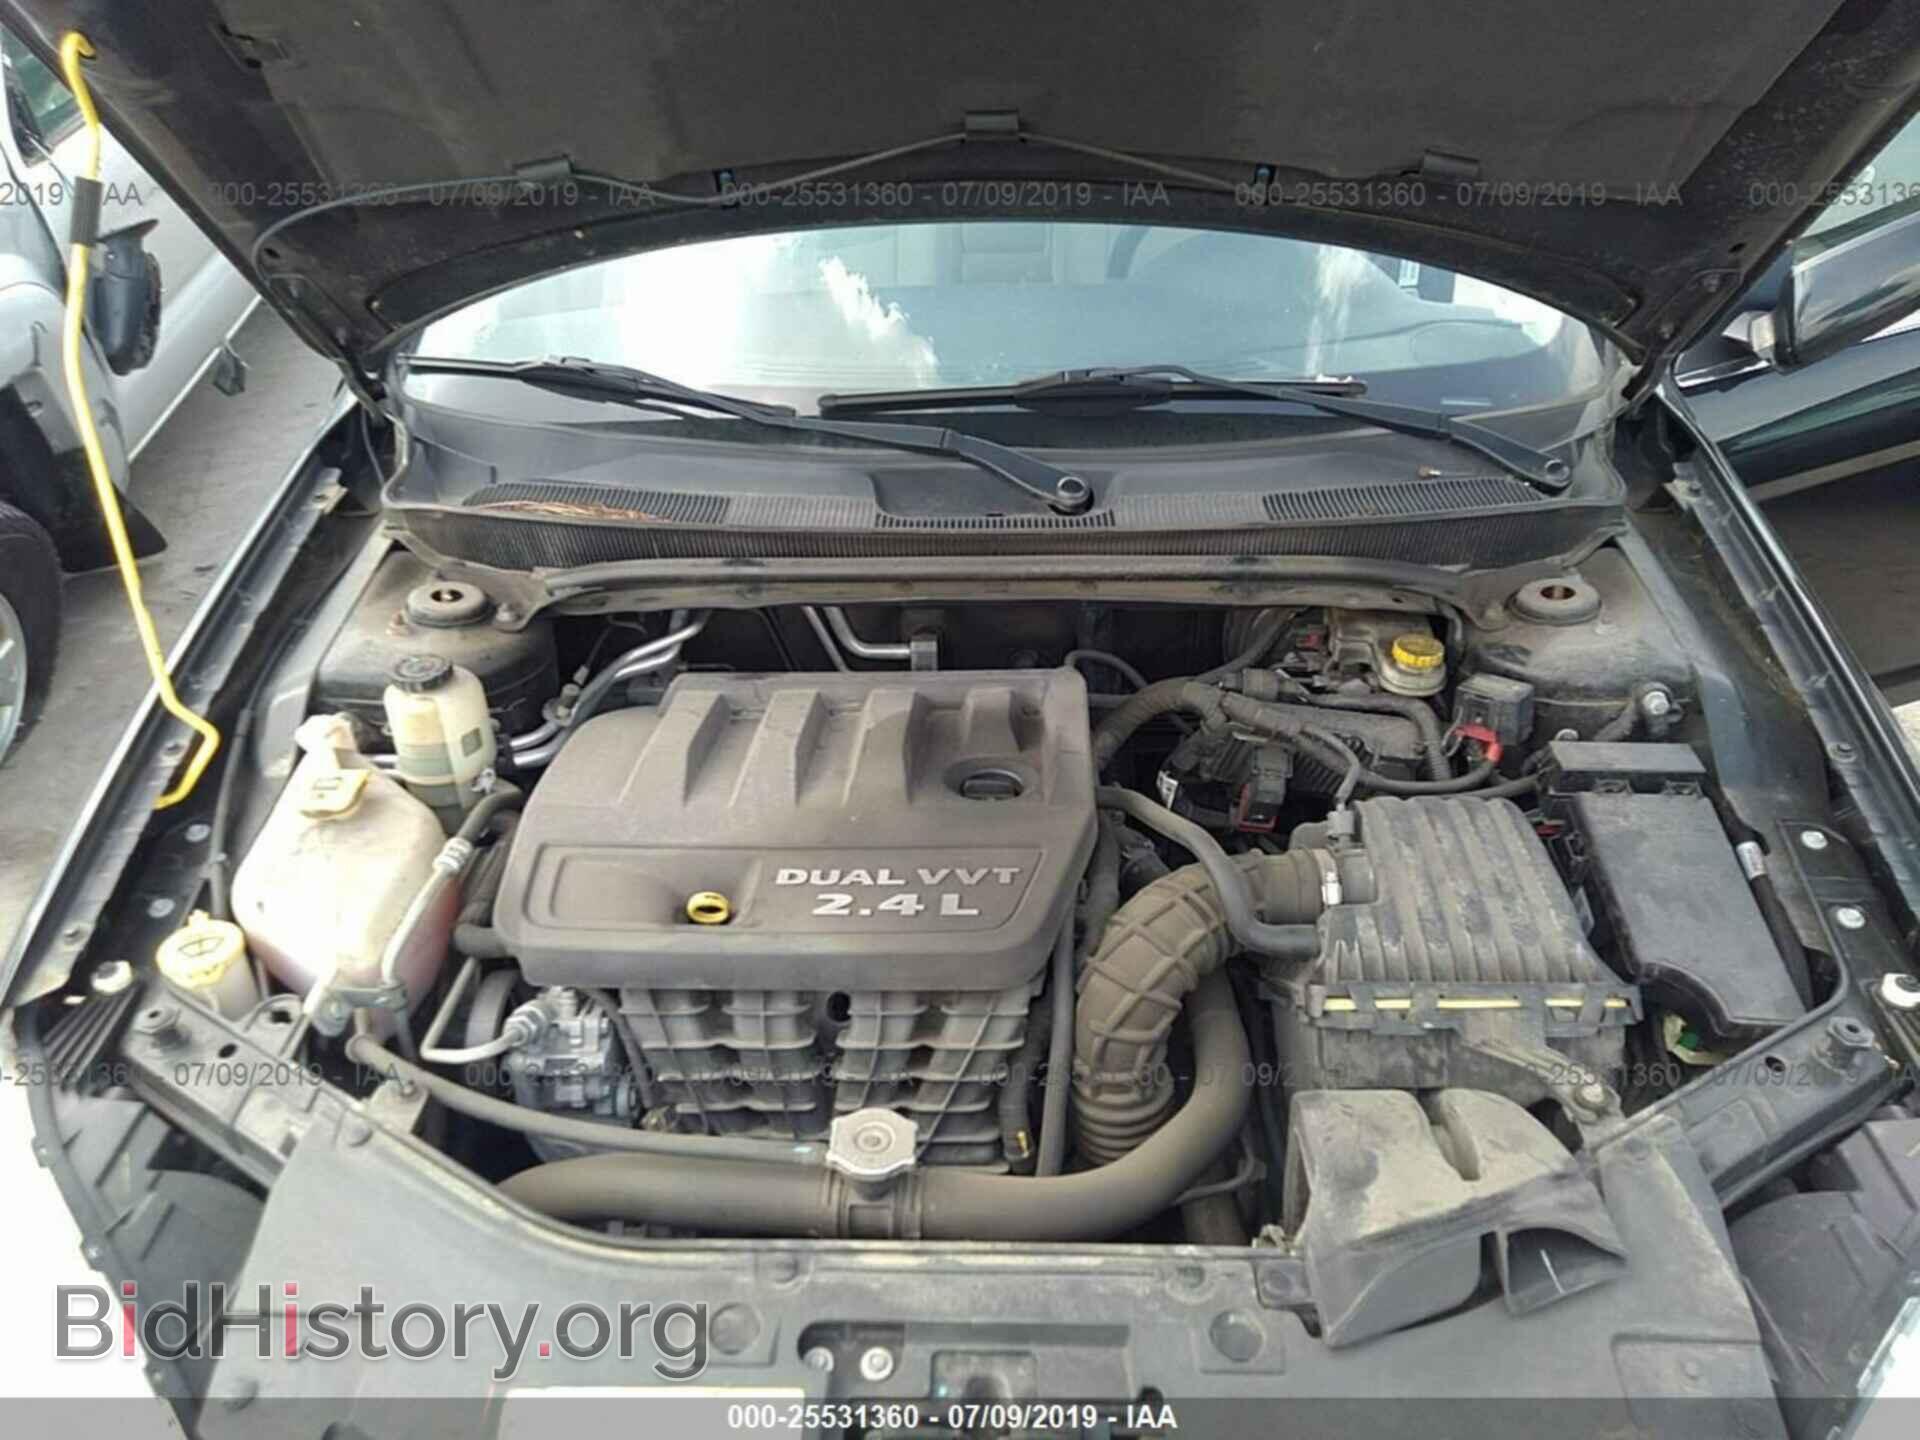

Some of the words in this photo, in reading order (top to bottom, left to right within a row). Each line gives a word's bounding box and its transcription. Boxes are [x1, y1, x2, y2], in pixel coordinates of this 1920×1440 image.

[775, 868, 907, 886] DUAL
[917, 868, 1021, 886] VVT
[812, 893, 925, 916] 2.4
[940, 893, 980, 916] L
